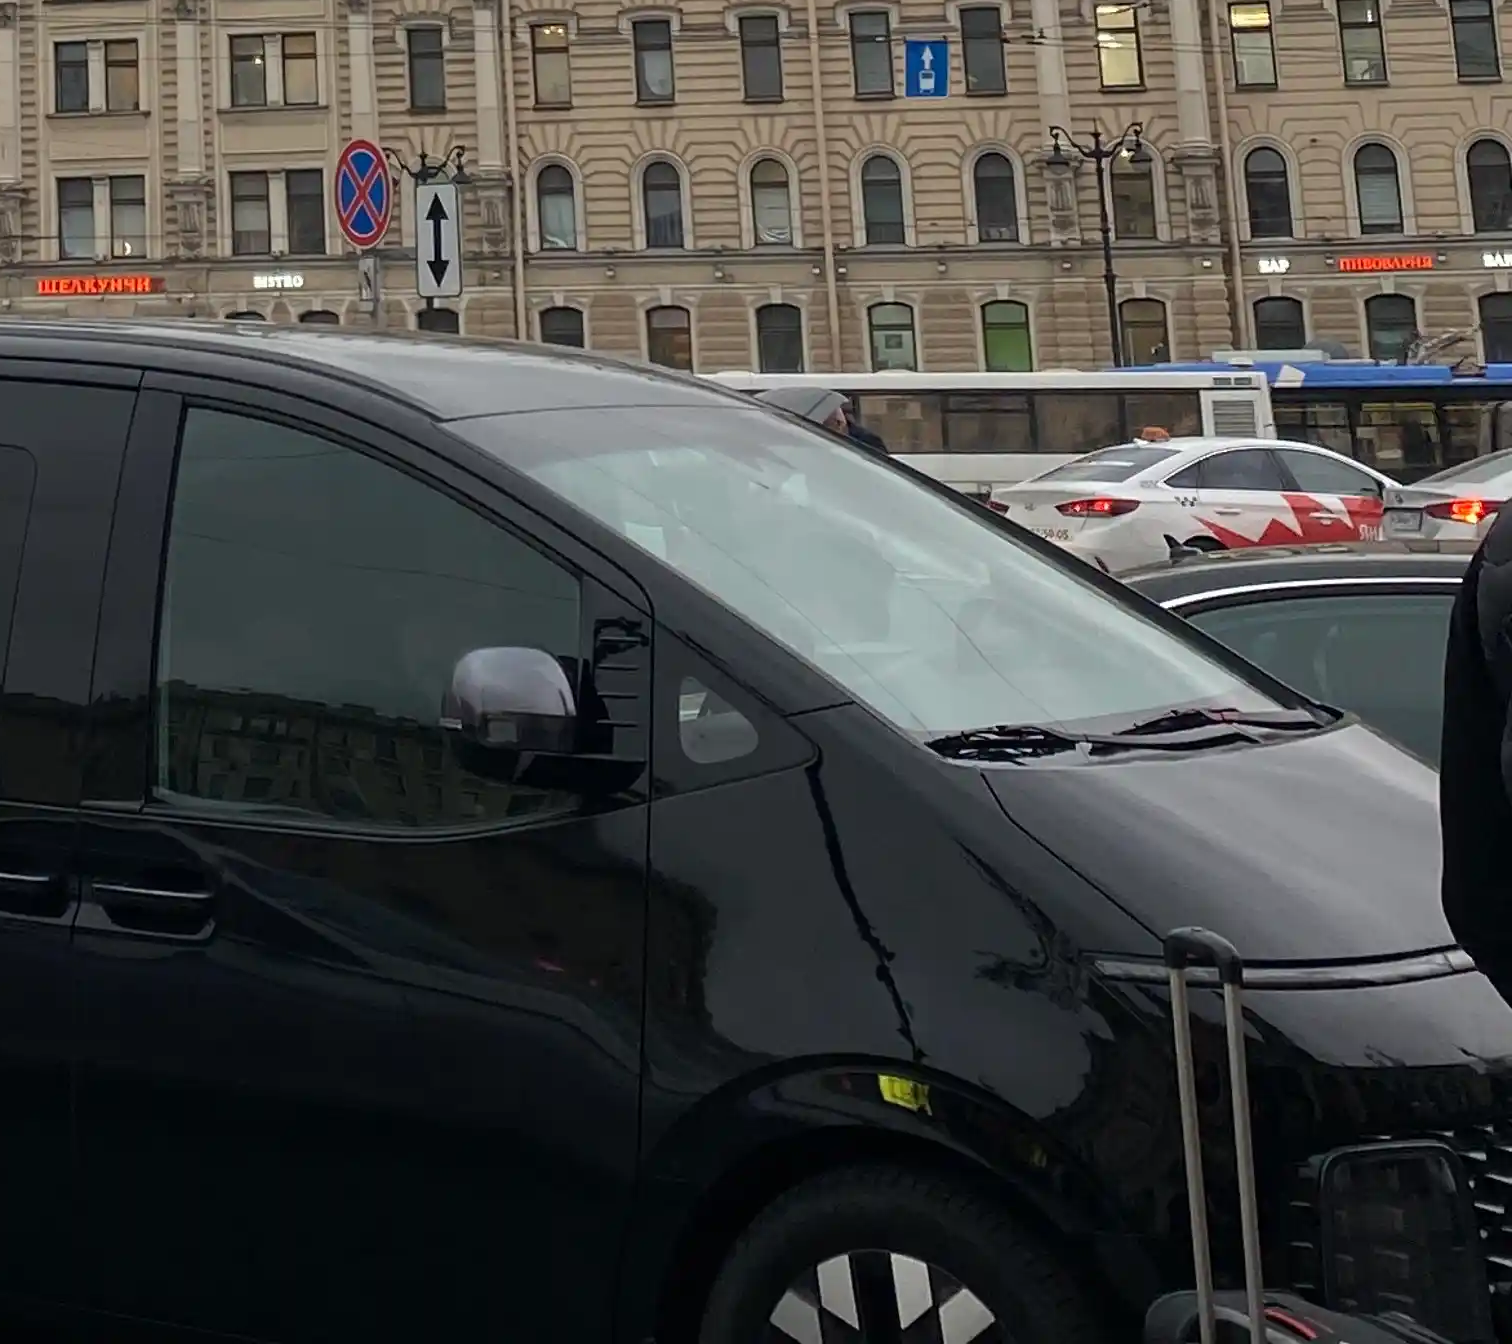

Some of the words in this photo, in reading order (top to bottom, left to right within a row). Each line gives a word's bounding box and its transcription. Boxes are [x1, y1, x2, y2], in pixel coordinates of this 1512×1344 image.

[1339, 254, 1433, 271] ПИВОВАРНЯ
[38, 276, 165, 295] ЩЕЛКУНЧИ
[253, 274, 304, 289] BISTRO
